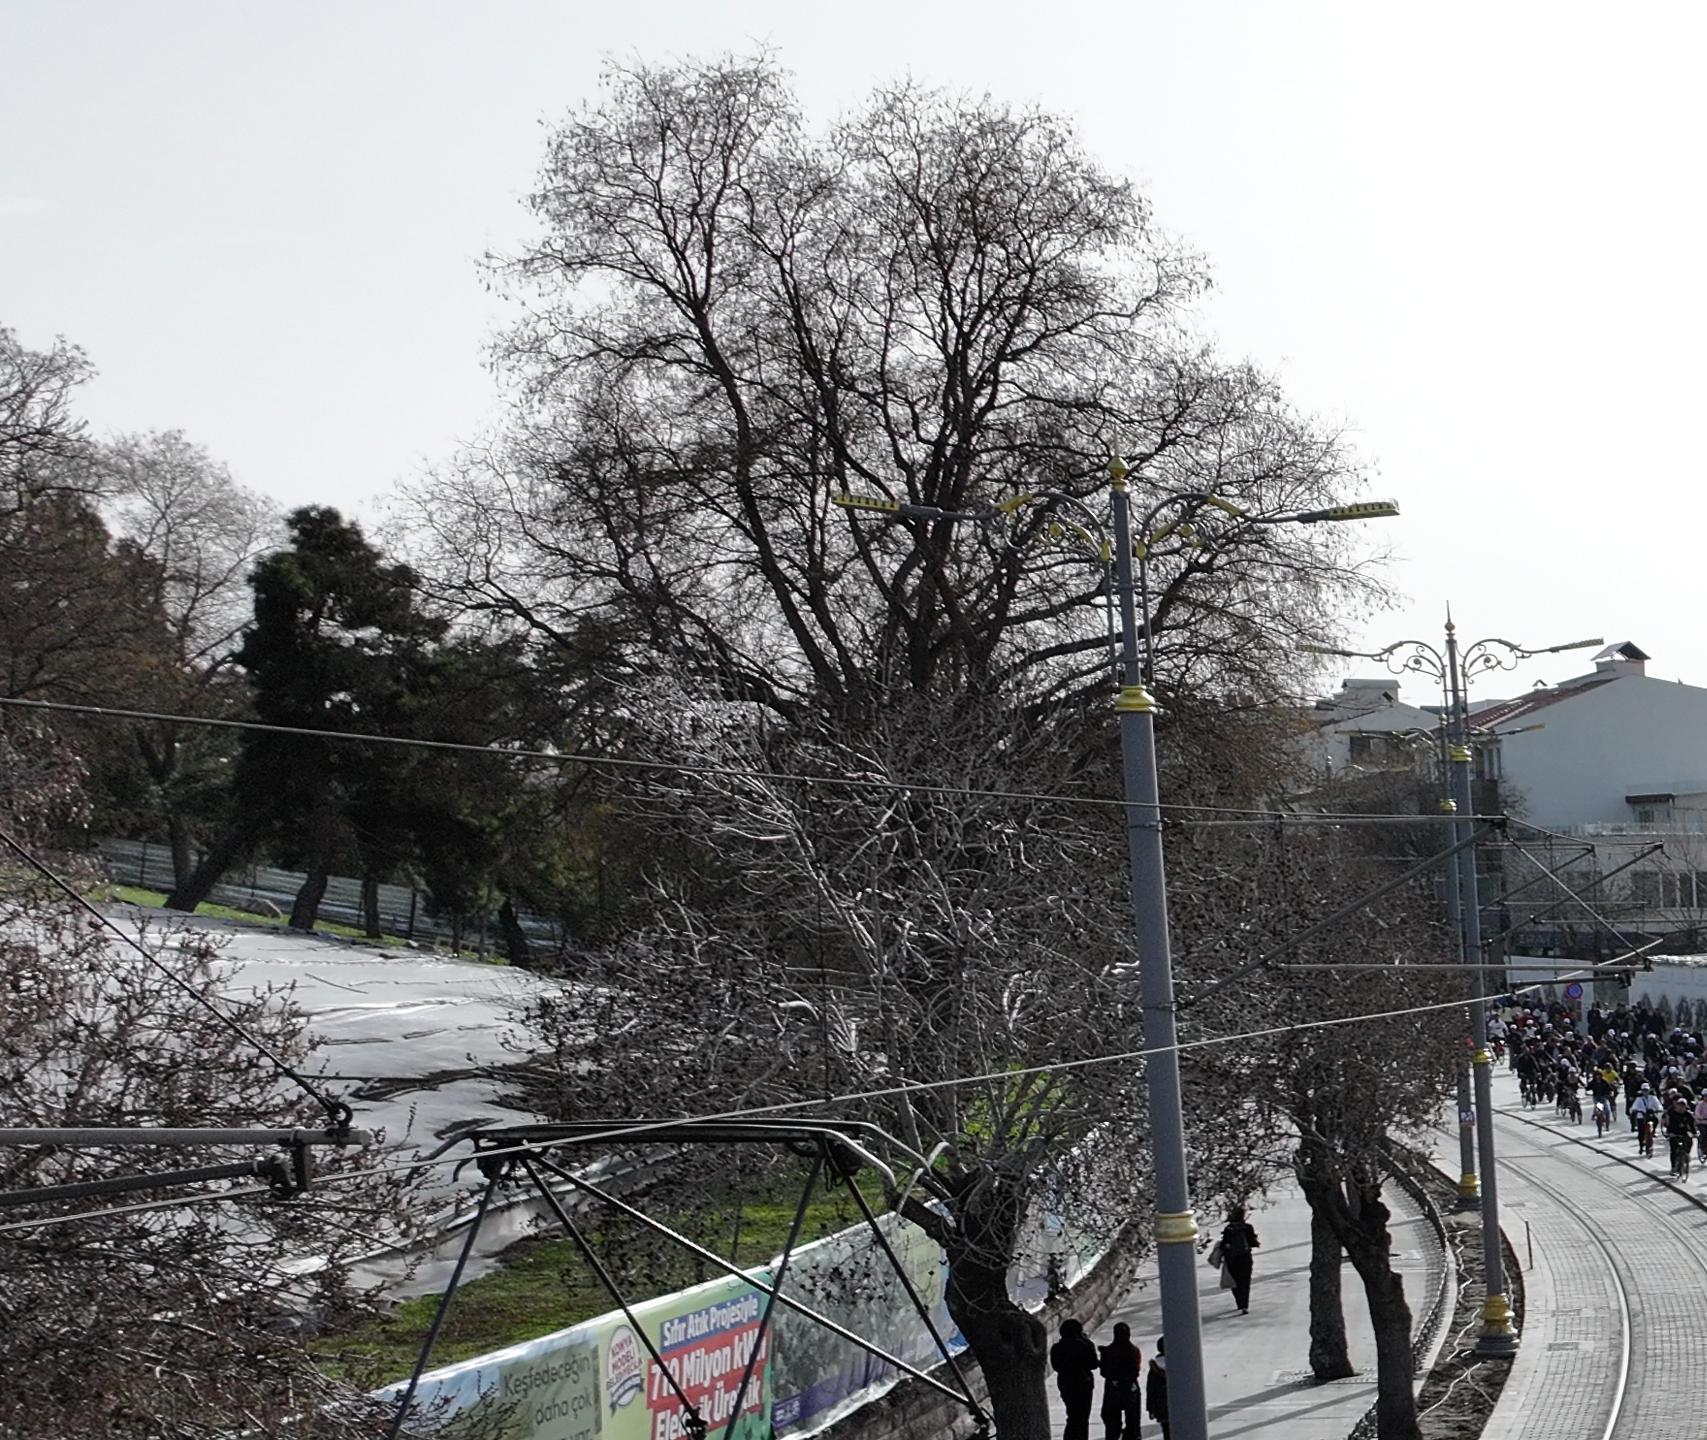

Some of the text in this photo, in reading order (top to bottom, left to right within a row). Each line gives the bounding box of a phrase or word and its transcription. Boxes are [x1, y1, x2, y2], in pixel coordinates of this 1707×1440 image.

[664, 1293, 759, 1346] Sıfır Atık Projesiyle
[504, 1355, 591, 1398] Keşfedeceğin
[682, 1345, 731, 1390] Milyon
[535, 1387, 593, 1425] daha çok
